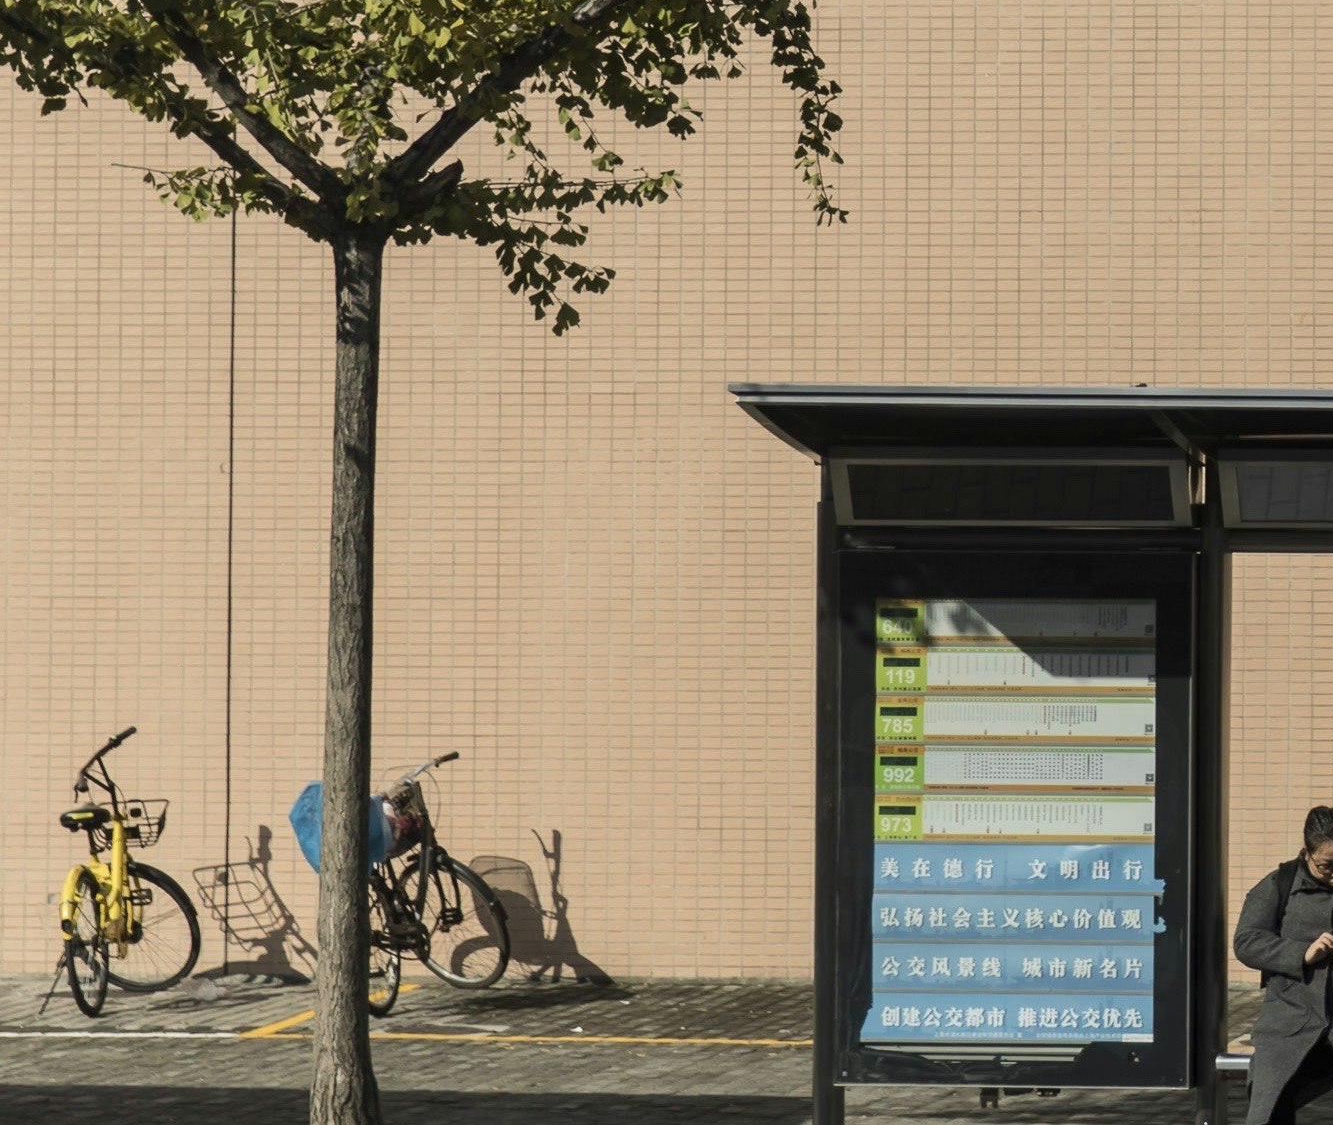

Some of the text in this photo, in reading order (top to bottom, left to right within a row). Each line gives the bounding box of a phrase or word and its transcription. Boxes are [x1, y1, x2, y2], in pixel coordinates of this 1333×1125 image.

[886, 669, 915, 684] 119
[882, 718, 913, 733] 785
[883, 768, 915, 783] 992
[881, 817, 912, 832] 973
[881, 858, 1143, 880] 美在德行 文明出行
[880, 907, 1142, 929] 弘扬社会主义核心价值观
[881, 956, 1143, 979] 公交风景线 城市新名片
[881, 1006, 1144, 1029] 创建公交都市 推进公交优先
